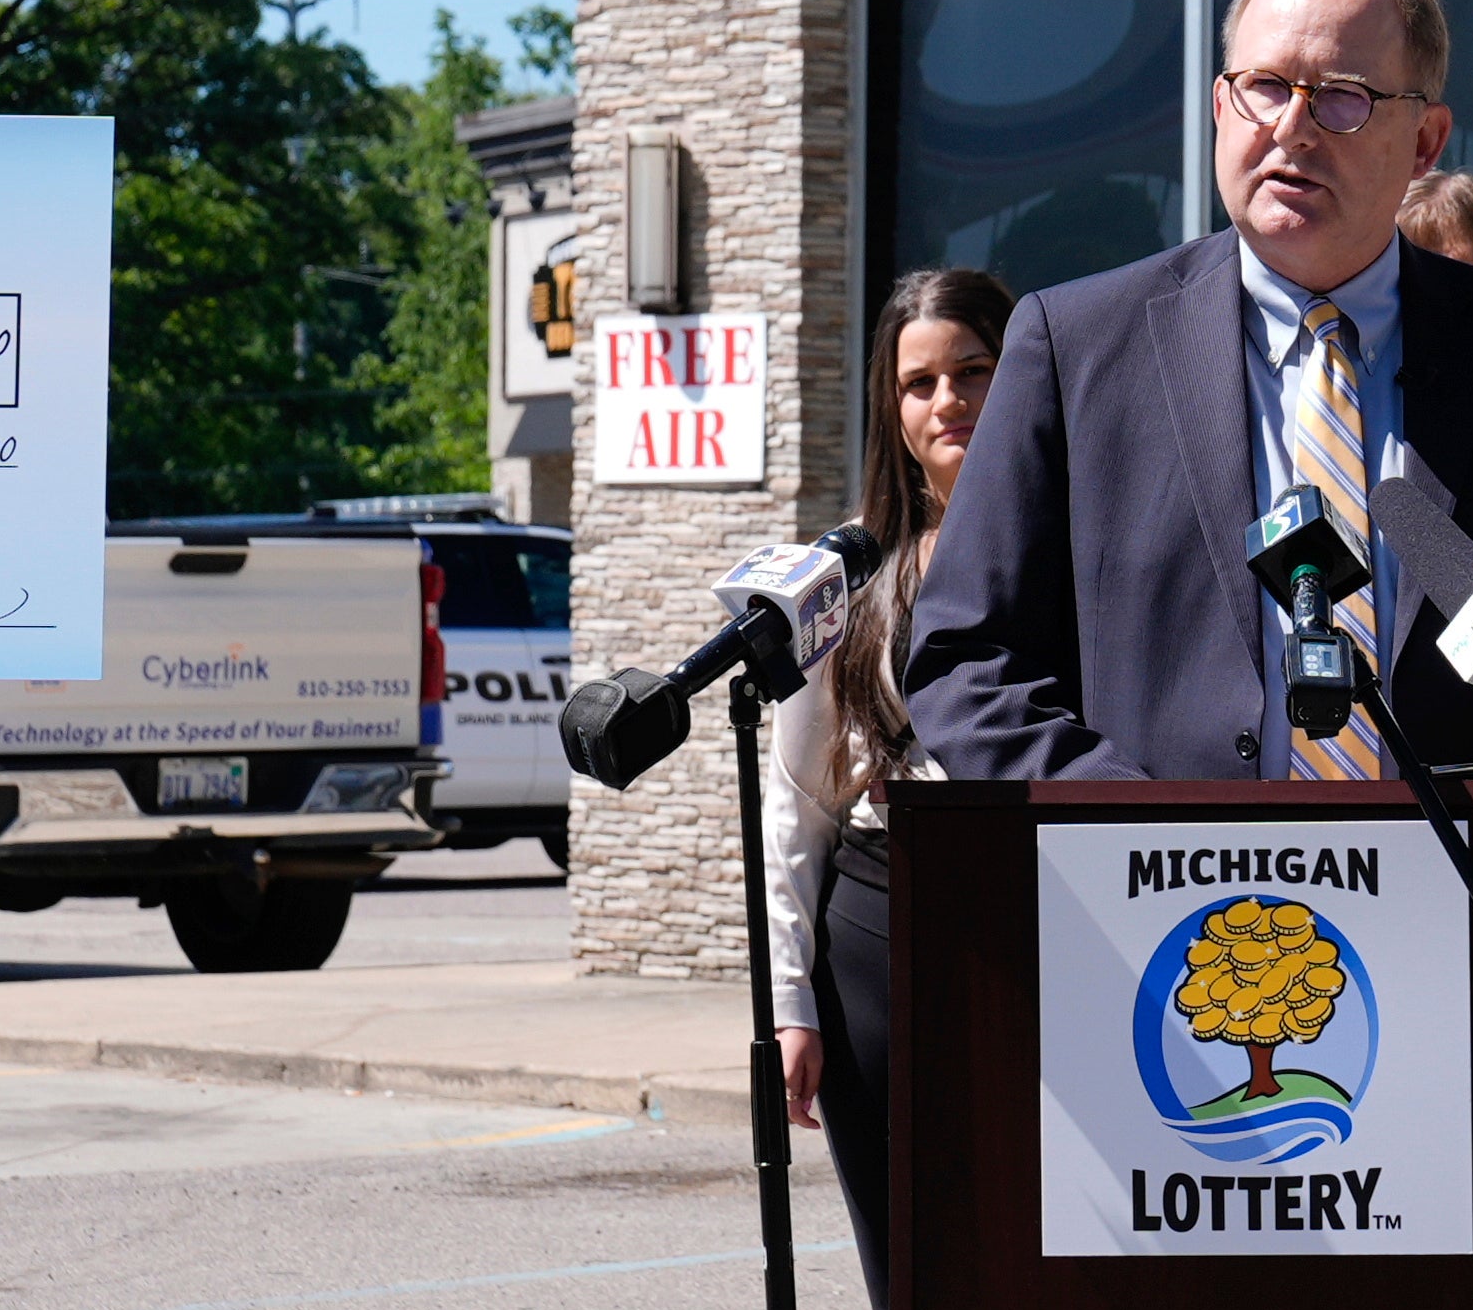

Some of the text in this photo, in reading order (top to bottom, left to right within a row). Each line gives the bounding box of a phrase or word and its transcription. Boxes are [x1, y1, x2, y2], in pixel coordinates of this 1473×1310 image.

[605, 325, 756, 389] FREE
[627, 409, 728, 468] AIR
[822, 585, 834, 609] abc
[142, 655, 269, 688] Cyberlink
[113, 723, 131, 741] at
[139, 722, 171, 741] the
[178, 721, 235, 741] Speed
[241, 721, 259, 738] of
[267, 721, 305, 739] Your
[312, 719, 400, 737] Business!
[1128, 847, 1379, 899] MICHIGAN
